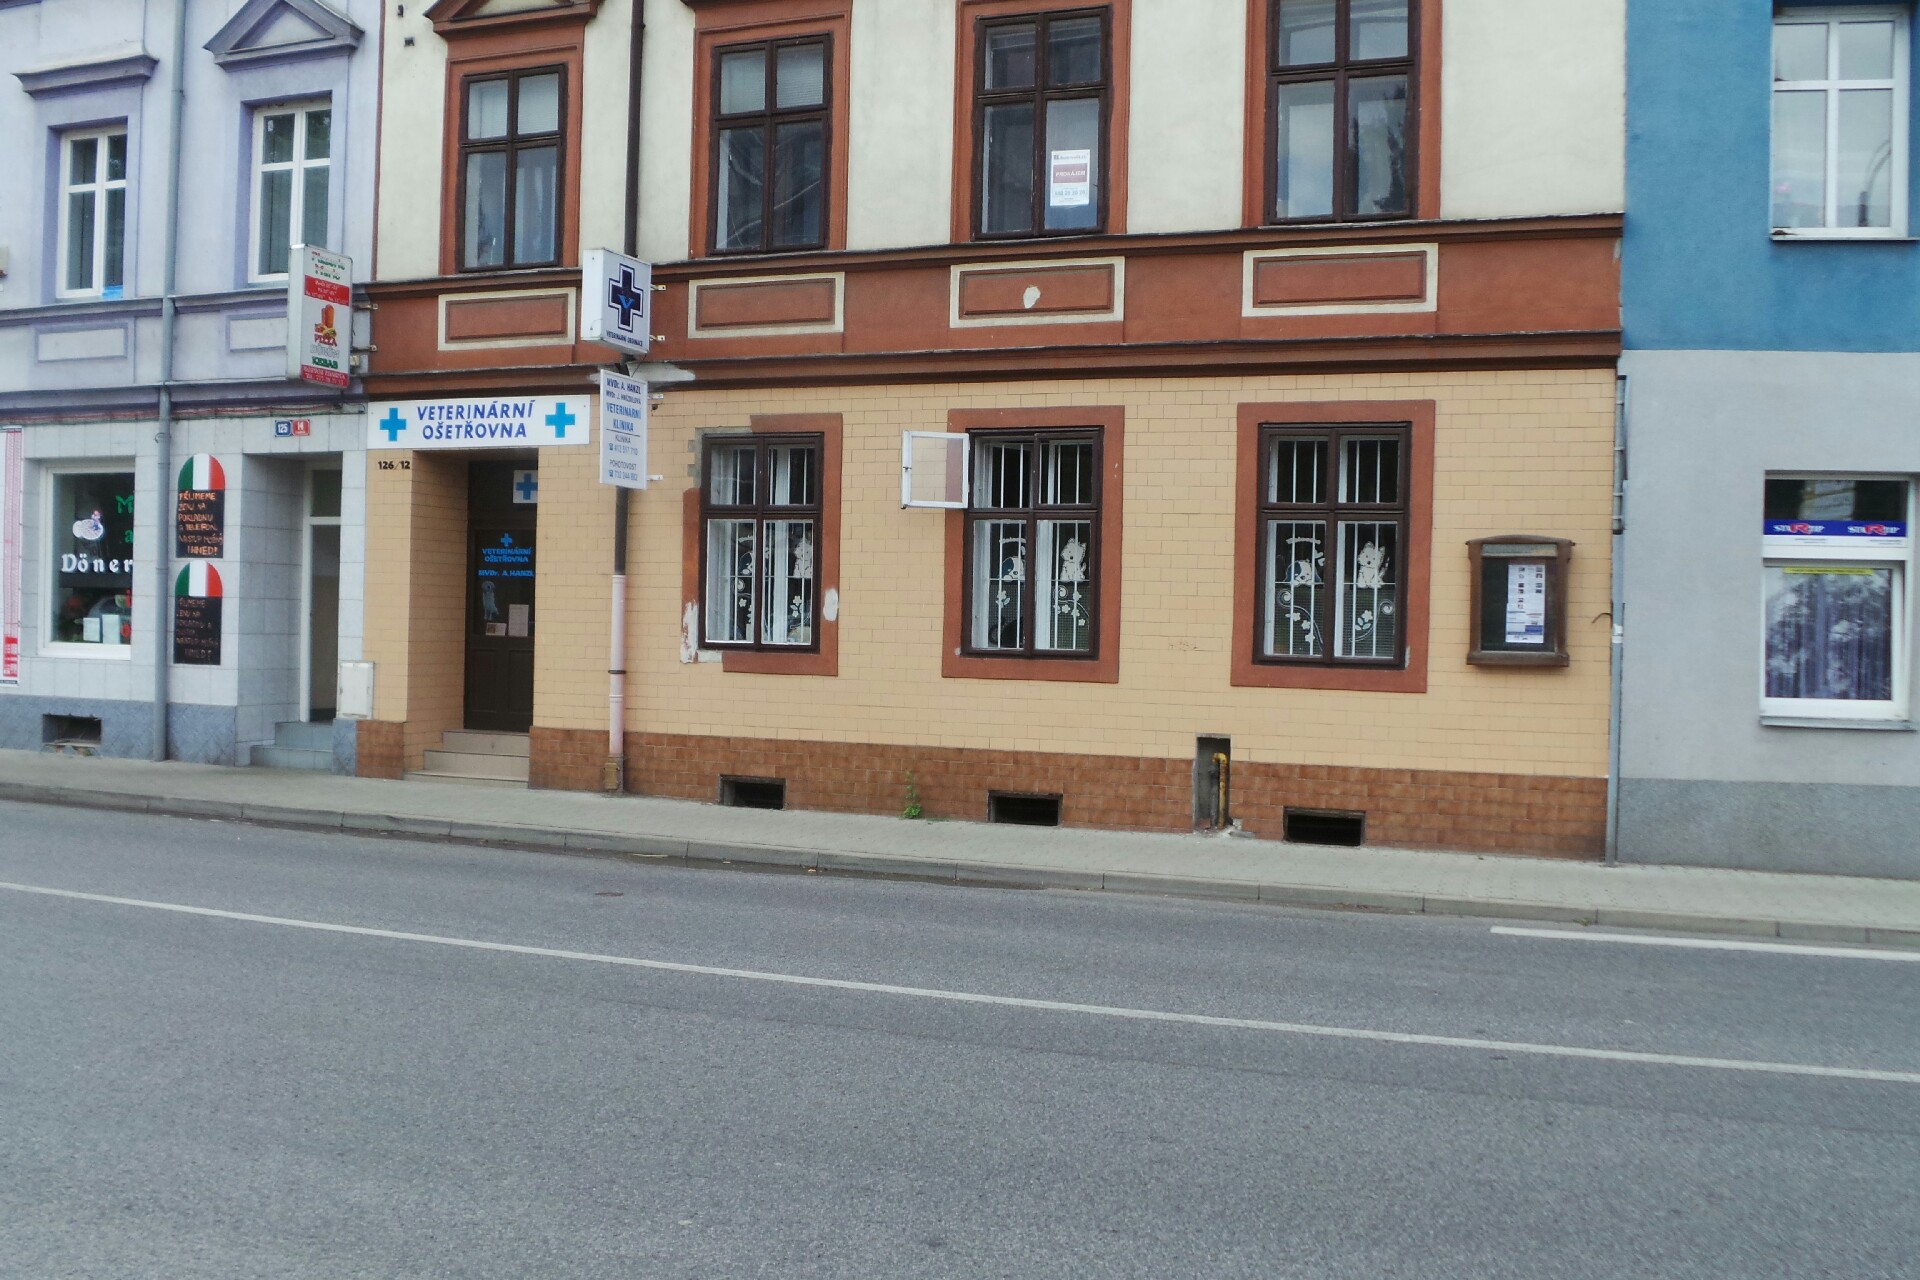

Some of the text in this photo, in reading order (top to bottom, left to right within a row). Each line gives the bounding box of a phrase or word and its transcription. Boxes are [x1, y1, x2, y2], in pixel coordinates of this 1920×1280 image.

[312, 356, 338, 369] KEBAB
[627, 383, 641, 395] HANZL
[417, 400, 536, 421] VETERINÁRNÍ
[606, 401, 641, 419] VETERINÁRNÍ
[277, 423, 288, 433] 125
[422, 420, 527, 440] OŠETŘOVNA
[613, 418, 634, 432] KLINIKA
[615, 434, 631, 443] KLINIKA
[378, 460, 411, 470] 126/12
[609, 459, 637, 471] POHOTOVOST
[482, 547, 532, 555] VETERINÁRNÍ
[61, 553, 133, 573] Döner
[484, 554, 529, 563] OŠETŘOVNA
